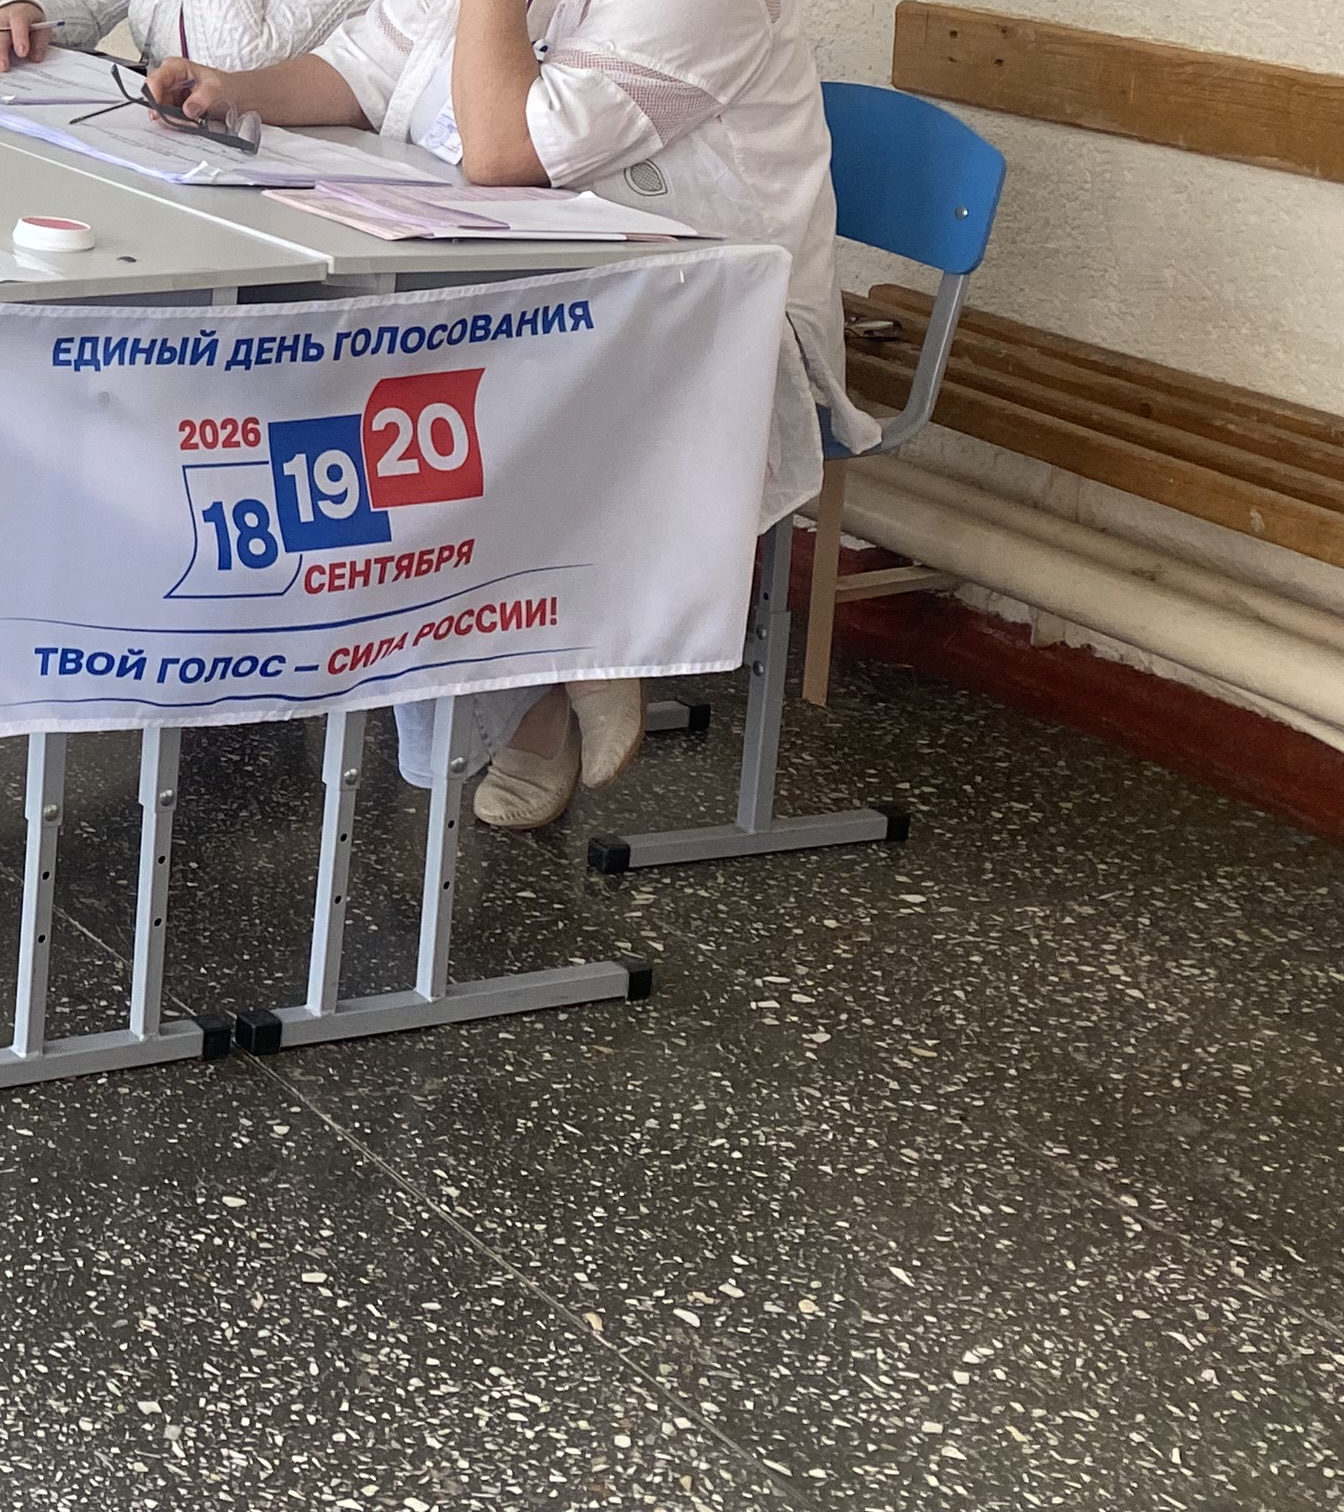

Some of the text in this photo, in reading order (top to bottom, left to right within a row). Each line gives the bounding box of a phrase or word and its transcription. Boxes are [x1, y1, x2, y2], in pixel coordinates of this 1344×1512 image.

[52, 300, 595, 373] ЕДИНЫЙ ДЕНЬ ГОЛОСОВАНИЯ
[178, 417, 261, 450] 2026
[202, 401, 470, 571] 18 19 20
[304, 538, 475, 595] СЕНТЯБРЯ
[34, 646, 147, 681] ТВОЙ
[157, 655, 286, 684] ГОЛОС
[327, 632, 406, 676] СИЛА
[413, 597, 558, 648] РОССИИ!
